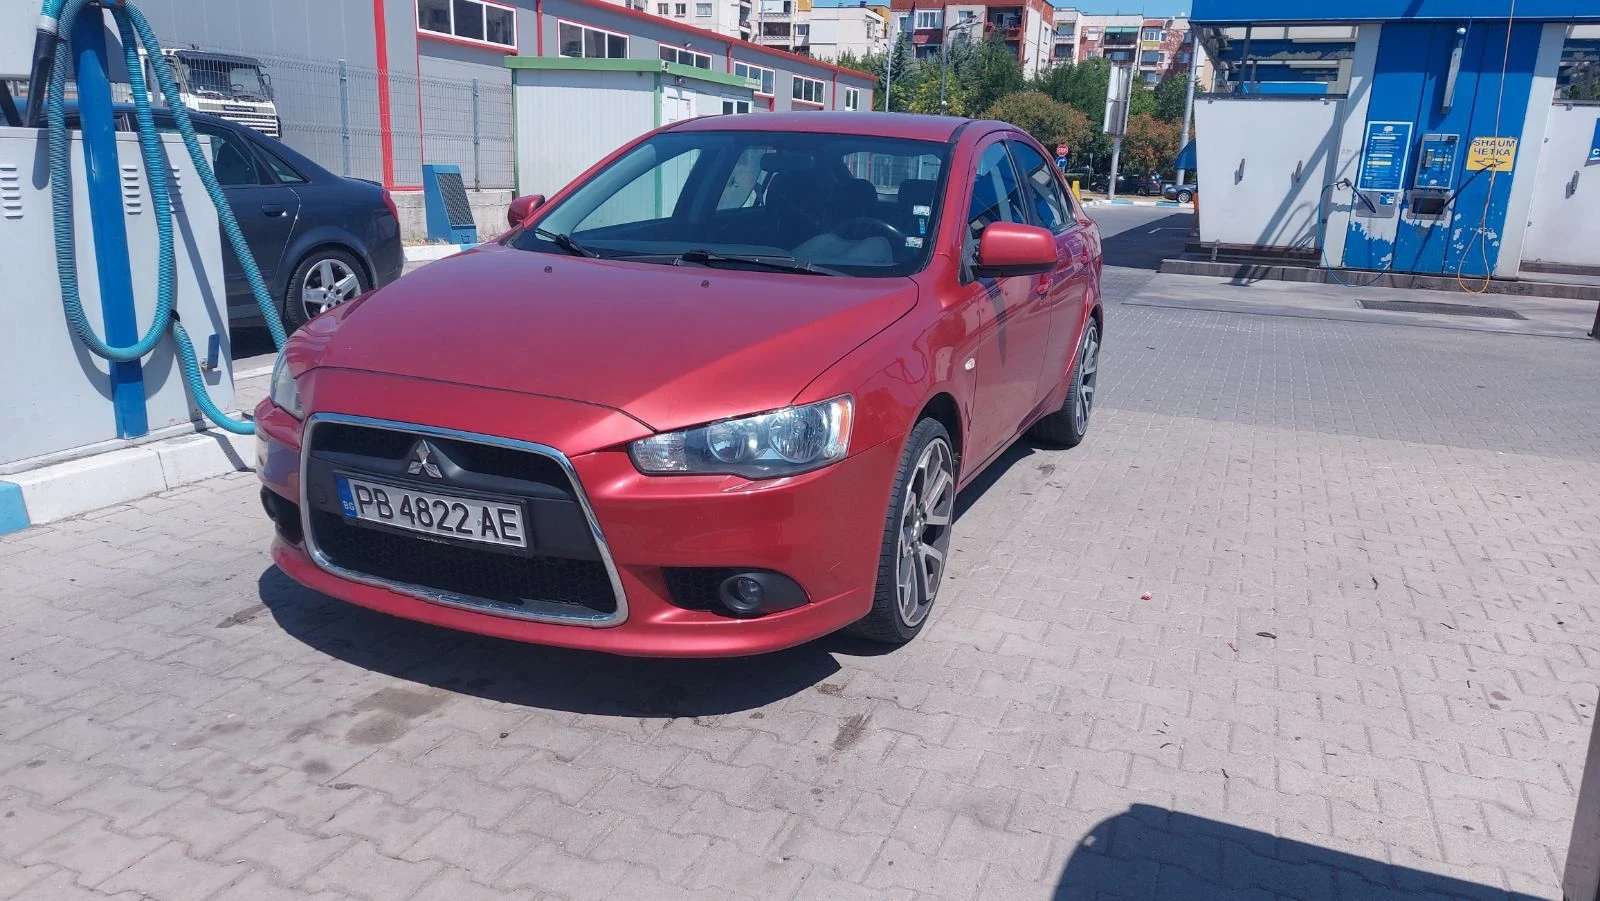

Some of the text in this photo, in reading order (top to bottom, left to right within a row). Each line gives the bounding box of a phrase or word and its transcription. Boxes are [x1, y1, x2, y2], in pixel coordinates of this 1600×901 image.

[1473, 139, 1515, 147] SHAUM
[1474, 148, 1511, 156] ЧЕТКА
[343, 501, 356, 511] BG
[354, 484, 521, 542] PB 4822 AE
